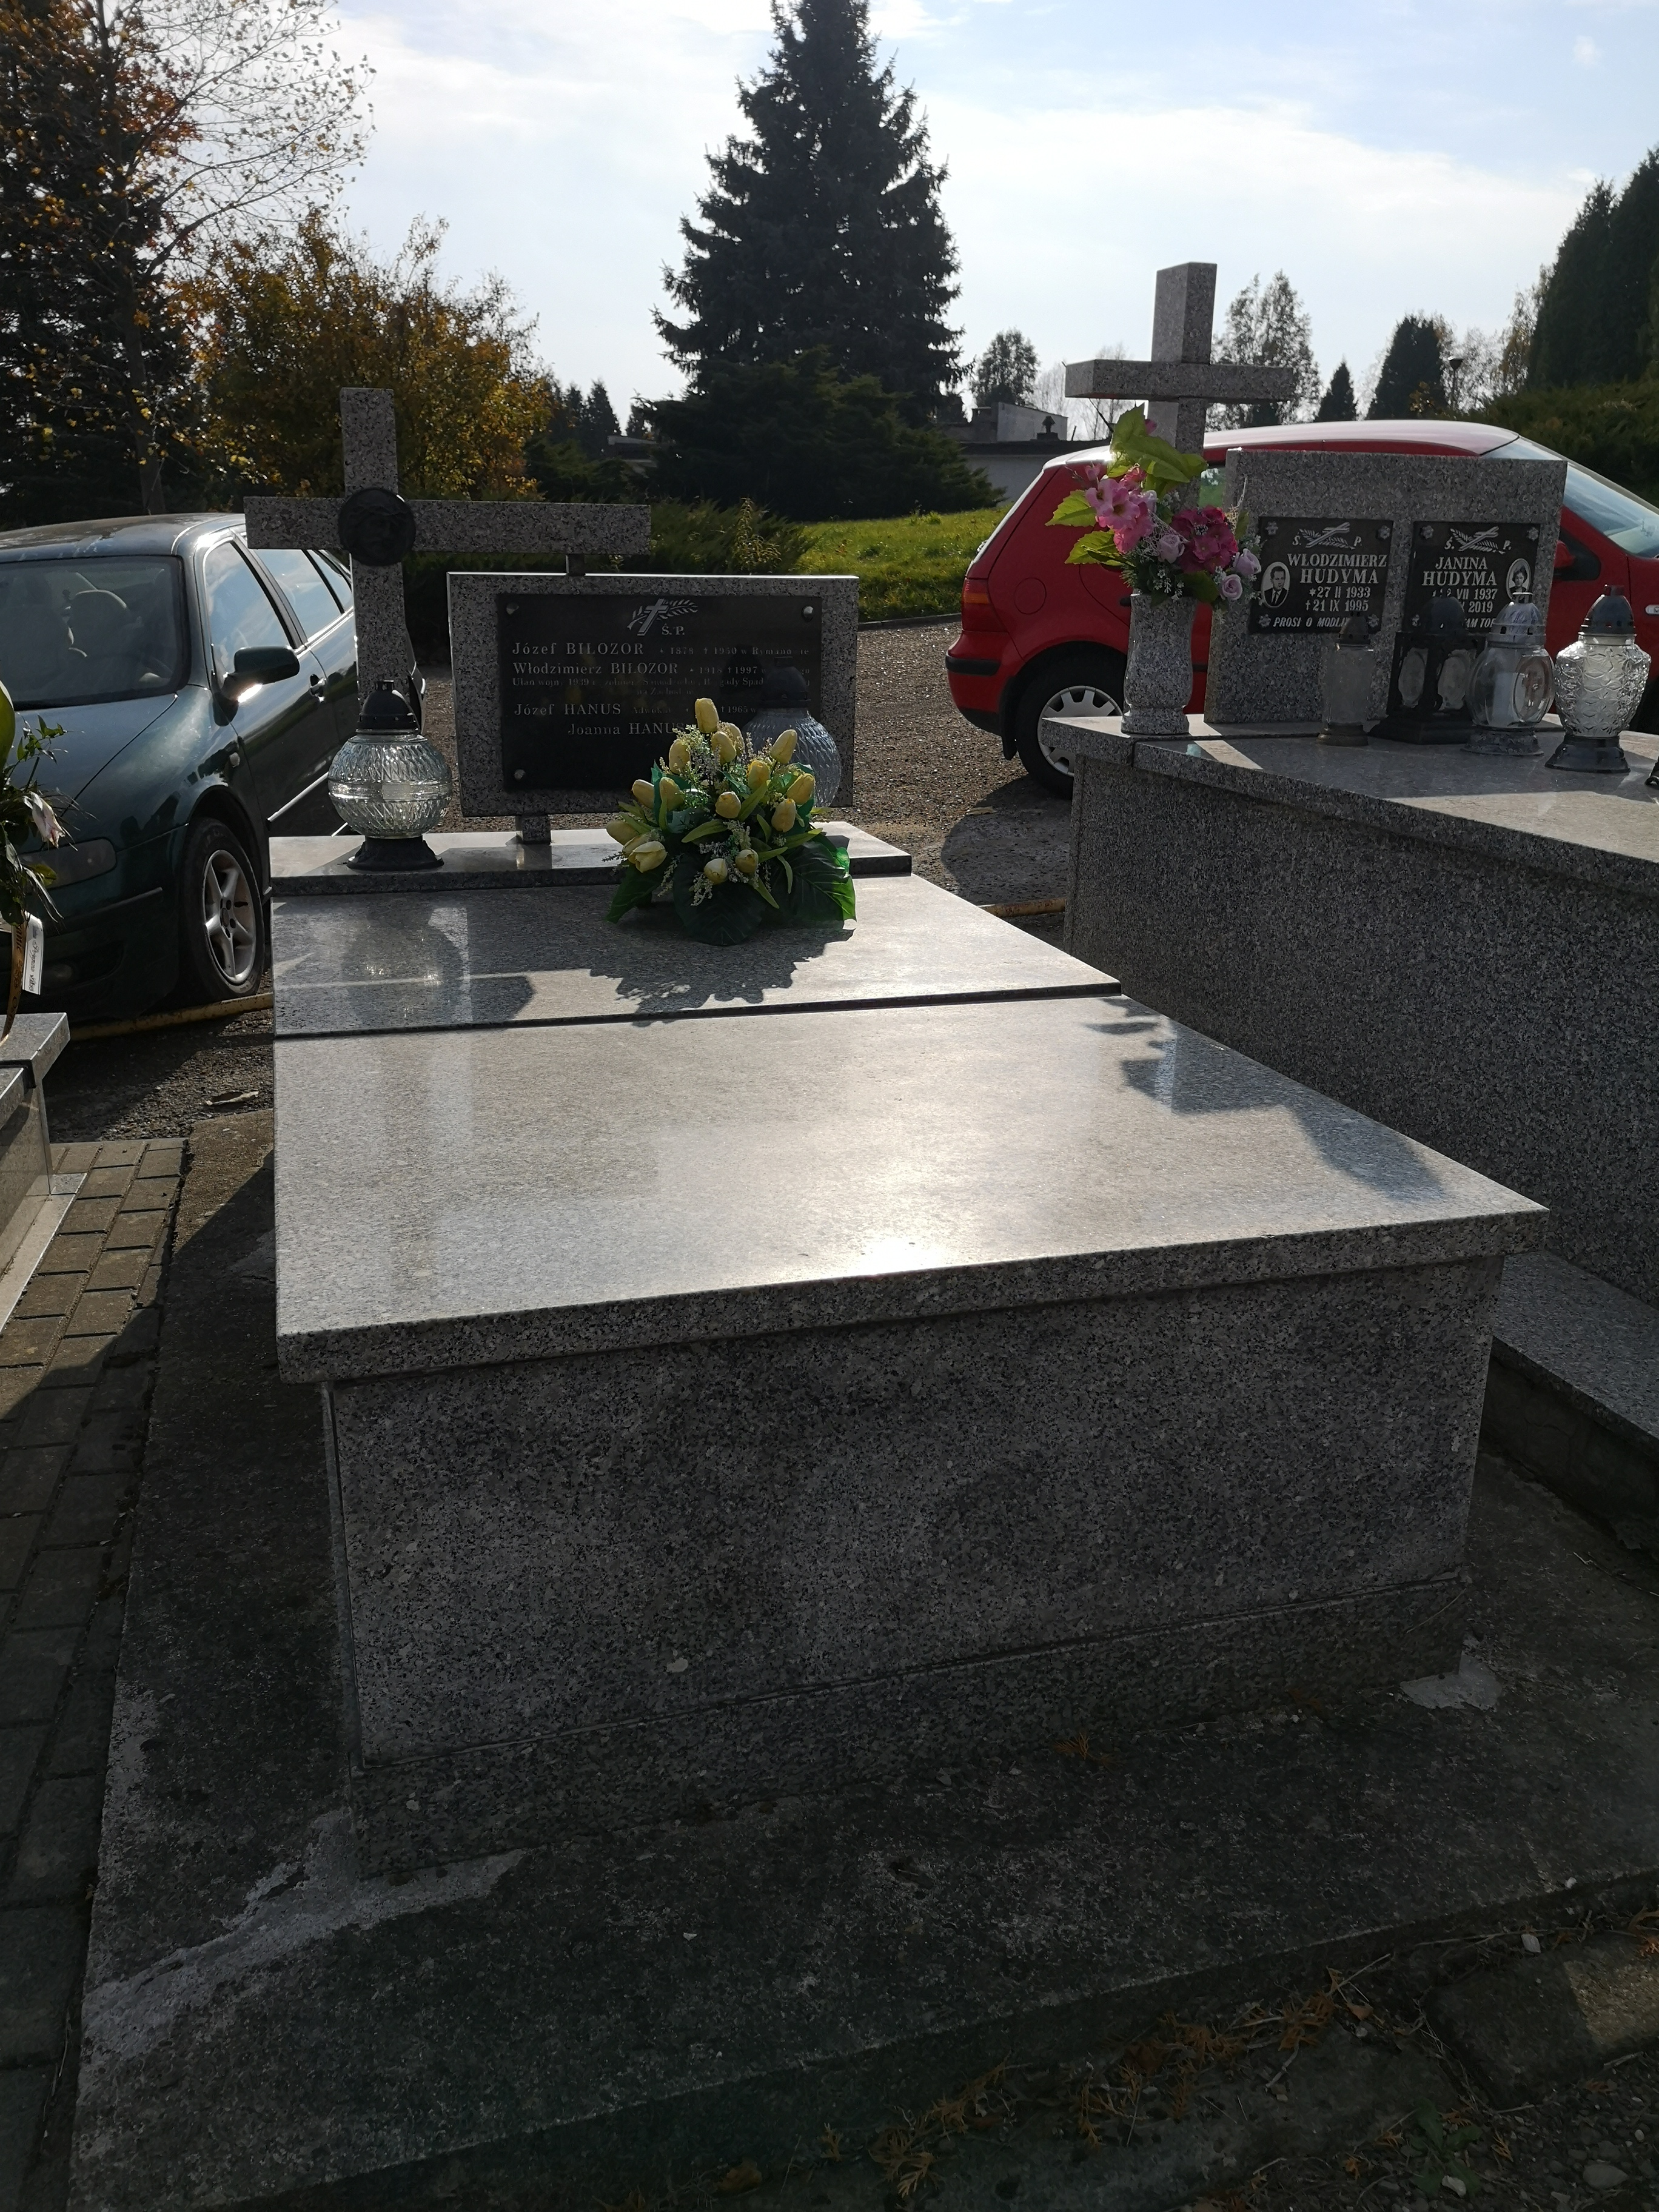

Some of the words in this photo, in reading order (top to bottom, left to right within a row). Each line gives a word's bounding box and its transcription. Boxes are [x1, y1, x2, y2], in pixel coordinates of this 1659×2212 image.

[1503, 540, 1512, 550] P.
[1287, 553, 1388, 568] WŁODZIMIERZ
[1435, 557, 1489, 570] JANINA
[1299, 568, 1379, 585] HUDYMA
[1421, 571, 1498, 586] HUDYMA
[1334, 586, 1342, 598] II
[1346, 586, 1372, 598] 1933
[1456, 588, 1469, 600] VII
[1473, 588, 1499, 600] 1937
[1329, 600, 1340, 612] IX
[1344, 598, 1369, 612] 1995
[1468, 601, 1493, 614] 2019
[1273, 616, 1302, 628] PROSI
[1305, 617, 1313, 628] O
[512, 642, 557, 655] Józef
[512, 662, 602, 674] Włodzimierz
[610, 662, 679, 674] BIŁOZOR
[735, 666, 758, 674] 1997
[514, 703, 555, 716] Józef
[563, 703, 622, 716] HANUS
[567, 723, 622, 735] Joanna
